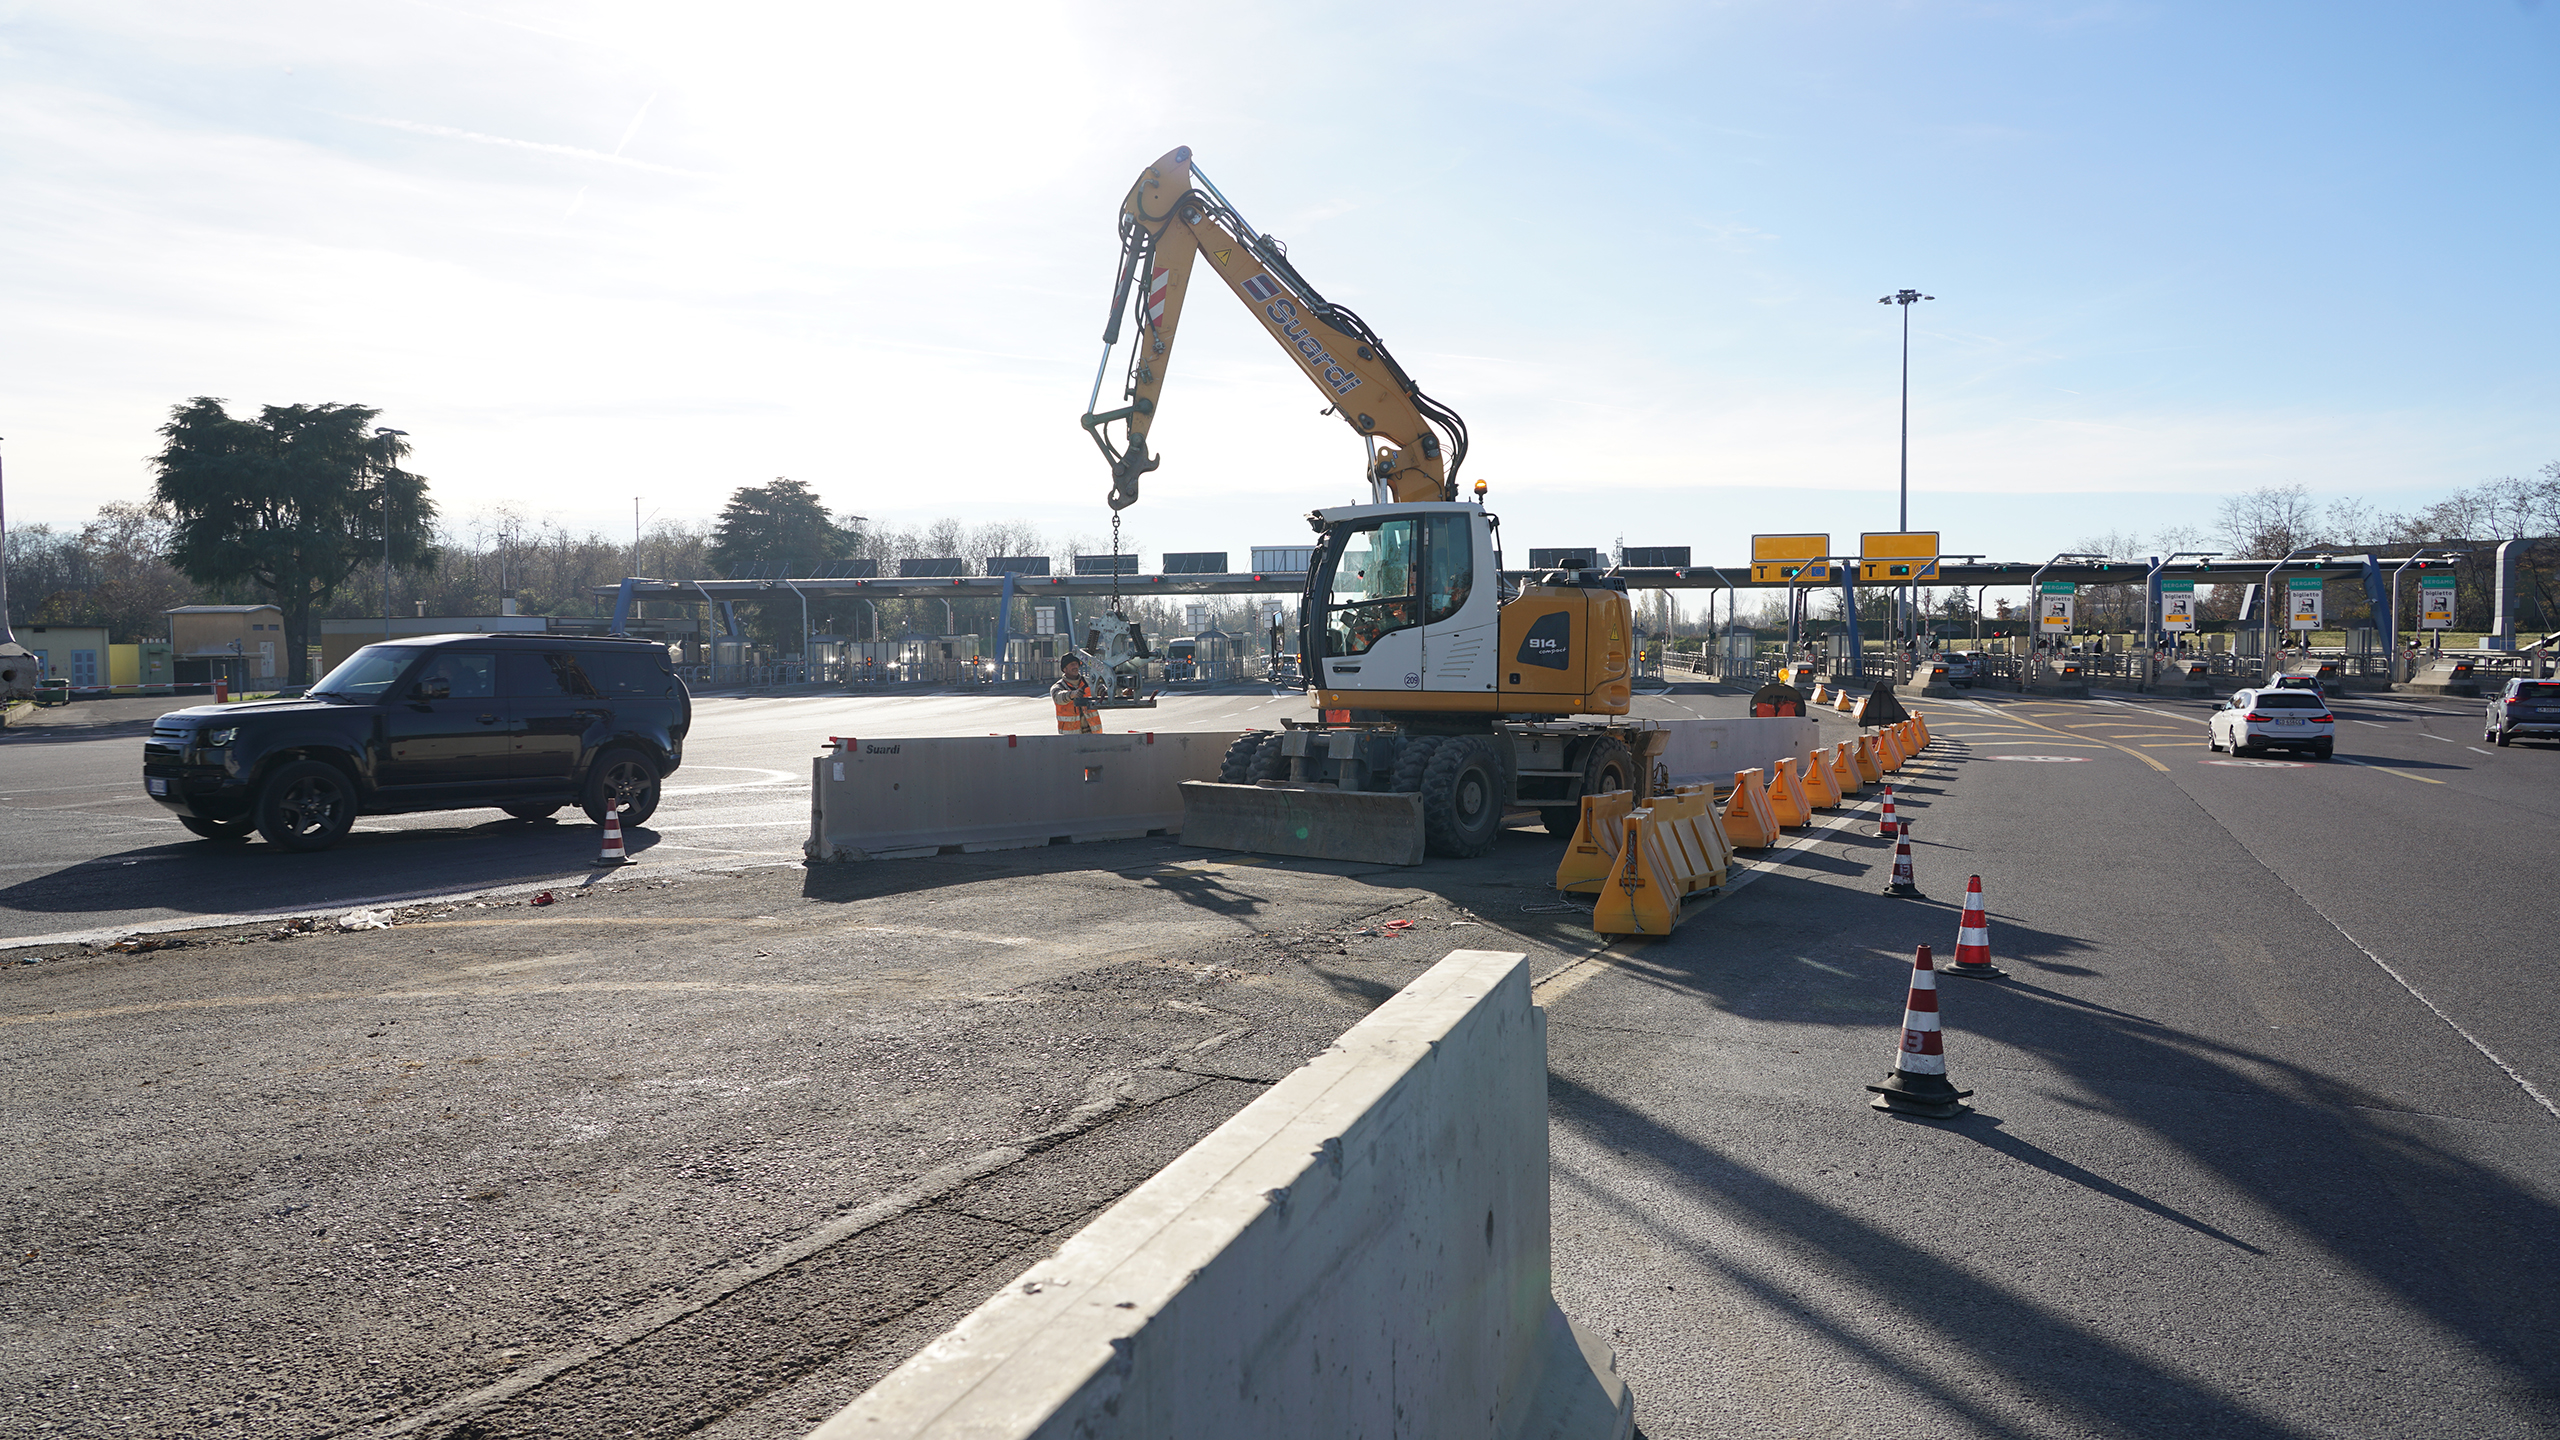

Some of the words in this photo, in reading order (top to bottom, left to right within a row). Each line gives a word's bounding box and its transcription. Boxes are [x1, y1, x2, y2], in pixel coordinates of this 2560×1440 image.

[1265, 298, 1363, 396] Suardi
[1756, 566, 1768, 579] T
[1865, 564, 1877, 577] T
[1529, 638, 1557, 648] 914
[1538, 647, 1567, 655] compact
[1406, 676, 1418, 685] 209
[865, 744, 901, 755] Suardi
